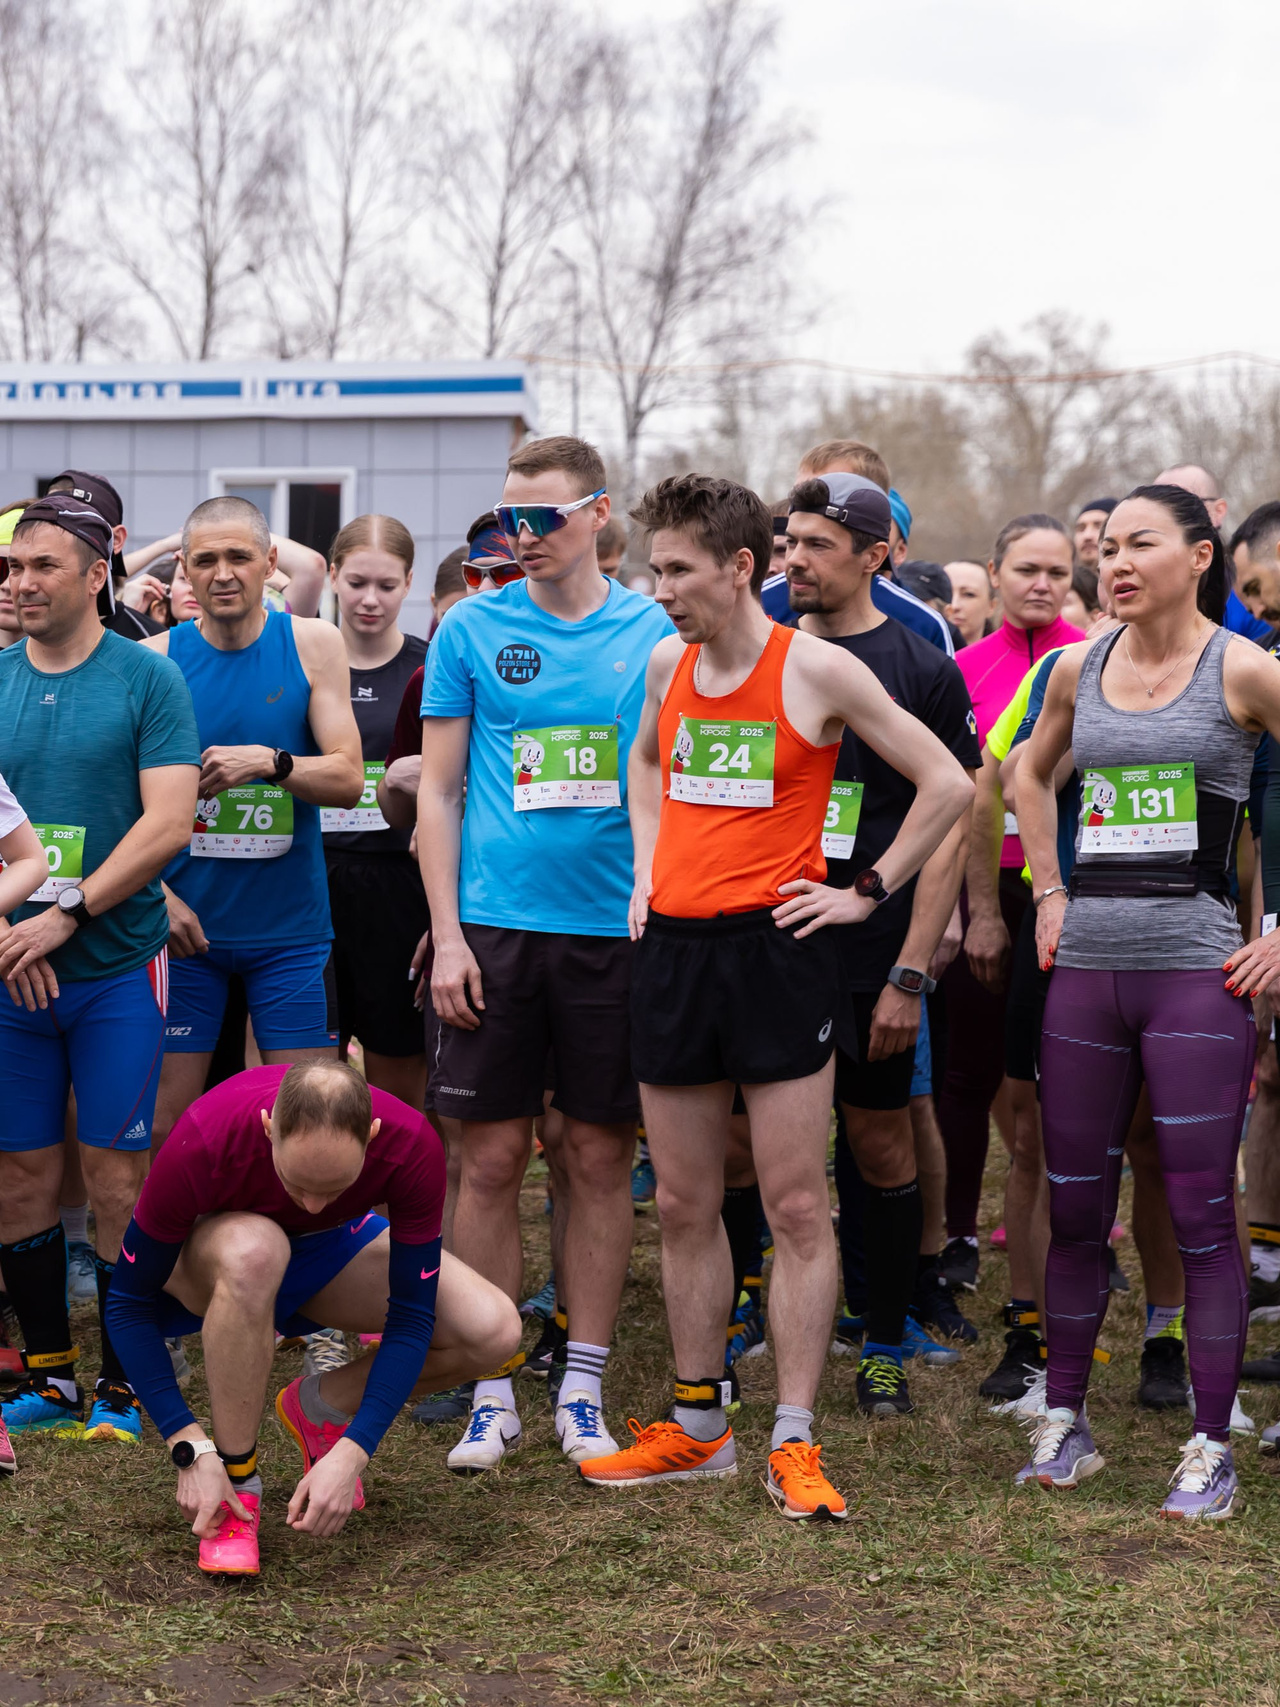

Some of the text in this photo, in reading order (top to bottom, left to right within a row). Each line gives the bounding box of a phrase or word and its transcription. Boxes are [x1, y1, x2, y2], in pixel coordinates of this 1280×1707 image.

[589, 731, 609, 740] 2025
[740, 728, 764, 737] 2025
[563, 747, 597, 775] 18
[709, 743, 752, 774] 24
[366, 766, 386, 774] 2025
[1158, 769, 1183, 780] 2025
[263, 790, 283, 798] 2025
[831, 786, 853, 796] 2025
[1128, 787, 1175, 819] 131
[236, 804, 273, 830] 76
[52, 830, 74, 839] 2025
[439, 1085, 477, 1097] noname
[124, 1130, 147, 1139] adidas
[38, 1354, 68, 1364] LIMETIME
